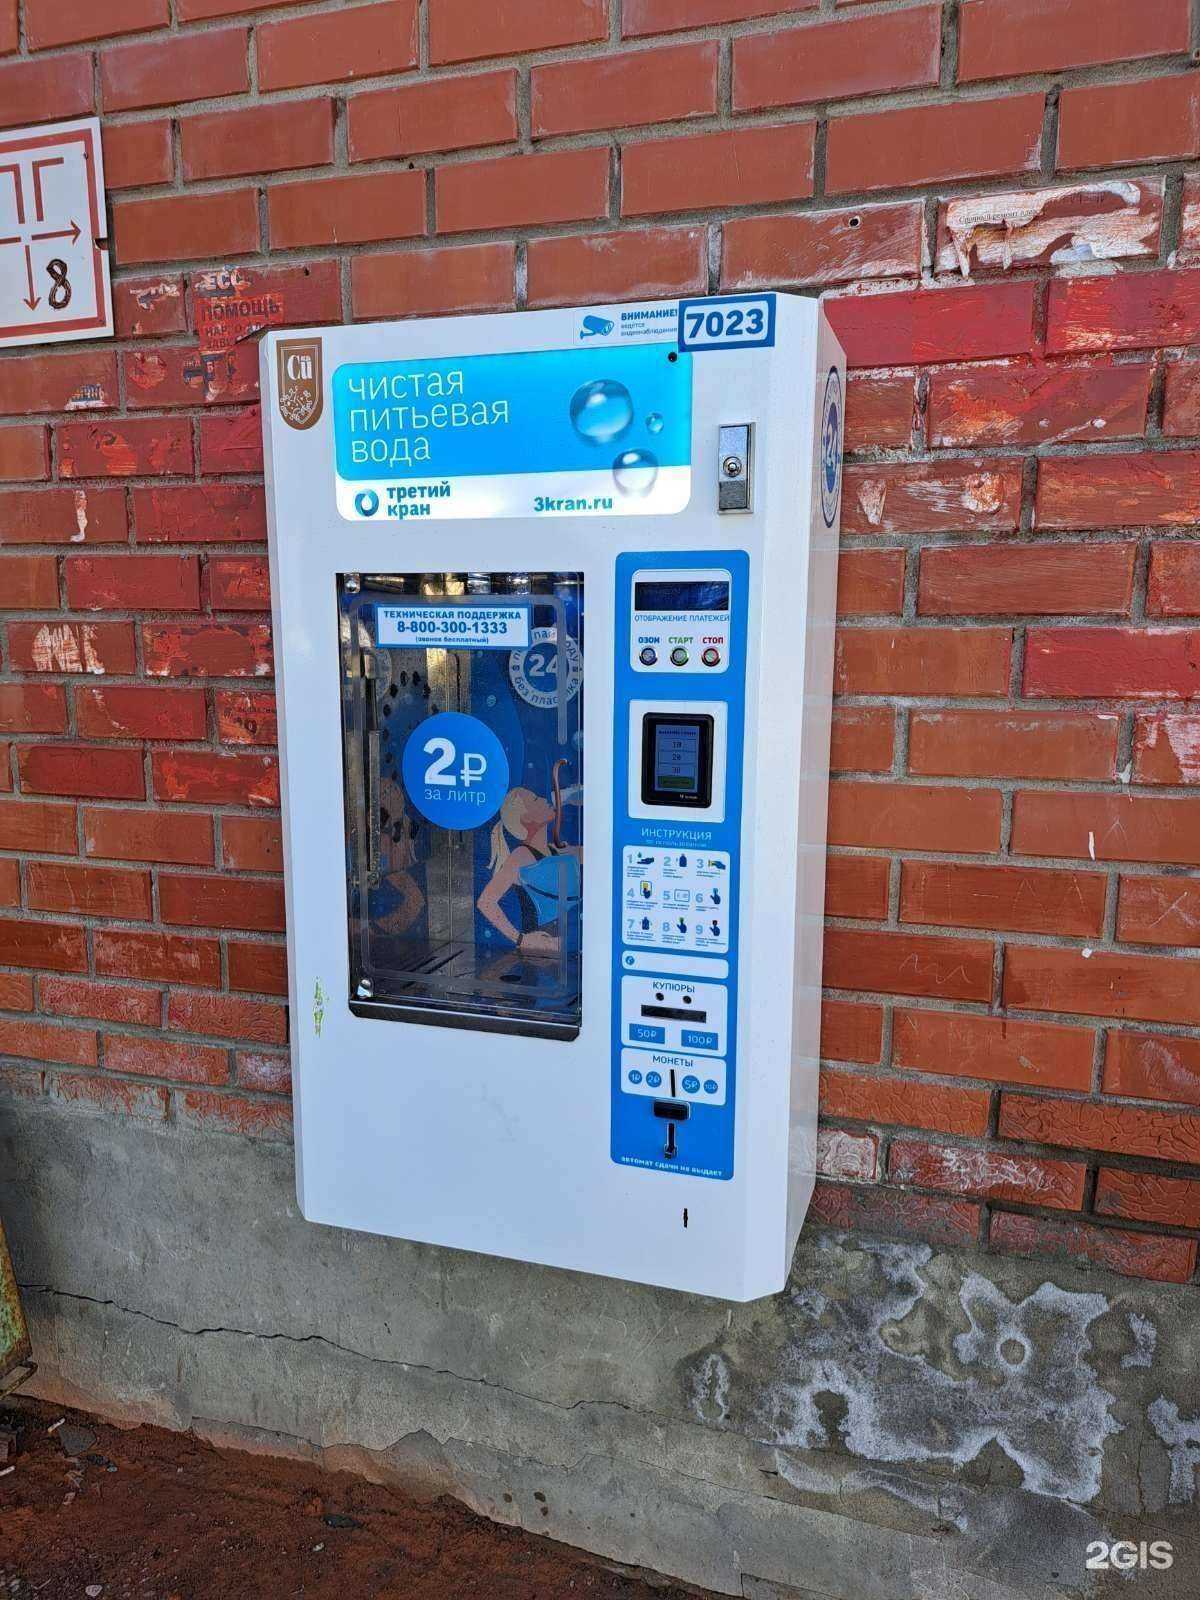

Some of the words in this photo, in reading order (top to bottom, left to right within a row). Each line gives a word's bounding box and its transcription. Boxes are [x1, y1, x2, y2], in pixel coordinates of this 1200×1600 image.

[46, 258, 72, 310] 8
[686, 308, 764, 340] 7023
[350, 400, 510, 432] питьевая
[352, 436, 432, 468] вода
[386, 480, 451, 503] третий
[533, 496, 613, 512] 3kran.ru
[387, 502, 431, 520] кран
[384, 610, 455, 619] ТЕХНИЧЕСКАЯ
[457, 610, 521, 620] ПОДДЕРЖКА
[634, 614, 687, 622] ОТОБРАЖЕНИЕ
[689, 615, 730, 623] ПЛАТЕЖЕЙ
[397, 621, 508, 634] 8-800-300-1333
[638, 636, 660, 644] ОЗОН
[668, 636, 694, 645] СТАРТ
[702, 637, 724, 645] СТОП
[424, 789, 442, 801] за
[447, 789, 487, 806] литр
[641, 828, 712, 841] ИНСТРУКЦИЯ
[626, 854, 633, 863] 1
[663, 856, 671, 867] 2
[696, 858, 704, 869] 3
[626, 888, 635, 898] 4
[663, 890, 671, 900] 5
[695, 893, 704, 903] 6
[626, 918, 635, 929] 7
[662, 921, 670, 932] 8
[695, 924, 704, 935] 9
[652, 981, 695, 993] КУПЮРЫ
[652, 1055, 694, 1067] МОНЕТЫ
